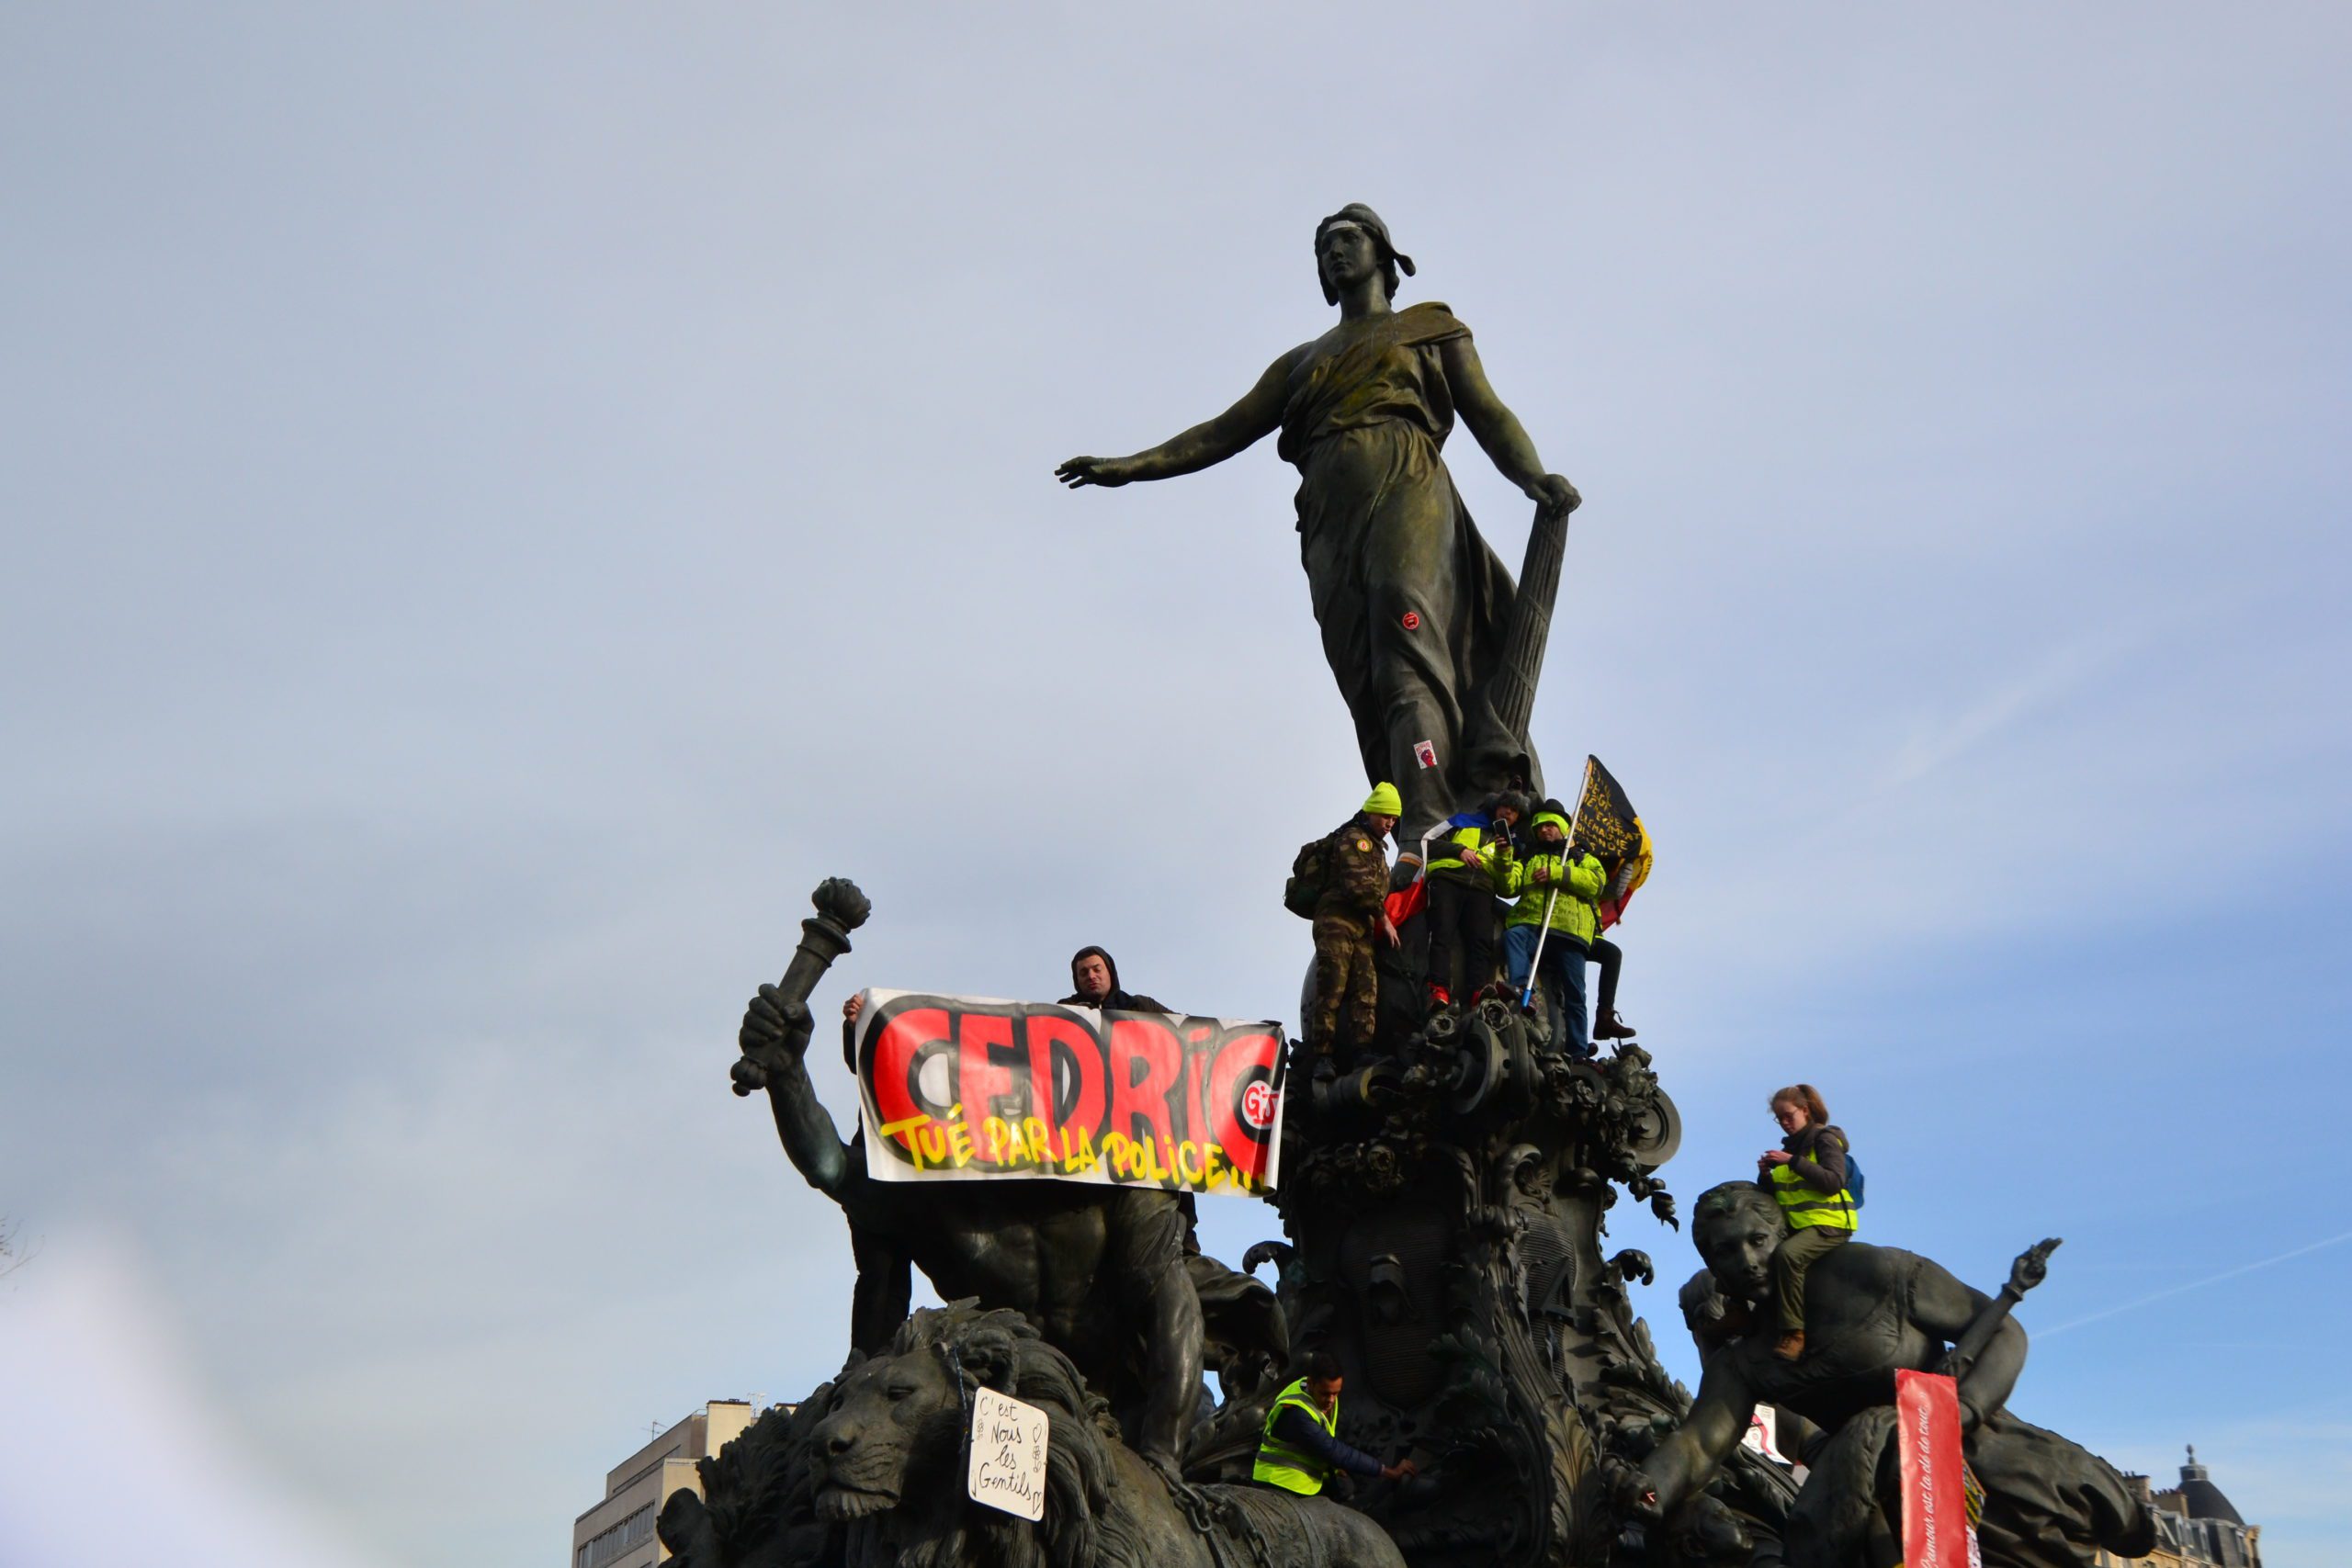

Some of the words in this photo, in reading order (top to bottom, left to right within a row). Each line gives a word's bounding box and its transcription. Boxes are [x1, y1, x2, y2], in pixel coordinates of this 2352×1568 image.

[880, 1103, 976, 1172] TUÉ
[983, 1115, 1058, 1167] PAR
[1059, 1125, 1101, 1173] LA
[979, 1396, 1018, 1421] C'est
[990, 1421, 1022, 1444] Nous
[995, 1444, 1017, 1470] les
[1917, 1437, 1930, 1454] de
[978, 1462, 1031, 1500] Gentils
[1918, 1475, 1933, 1491] la
[1920, 1493, 1933, 1514] est
